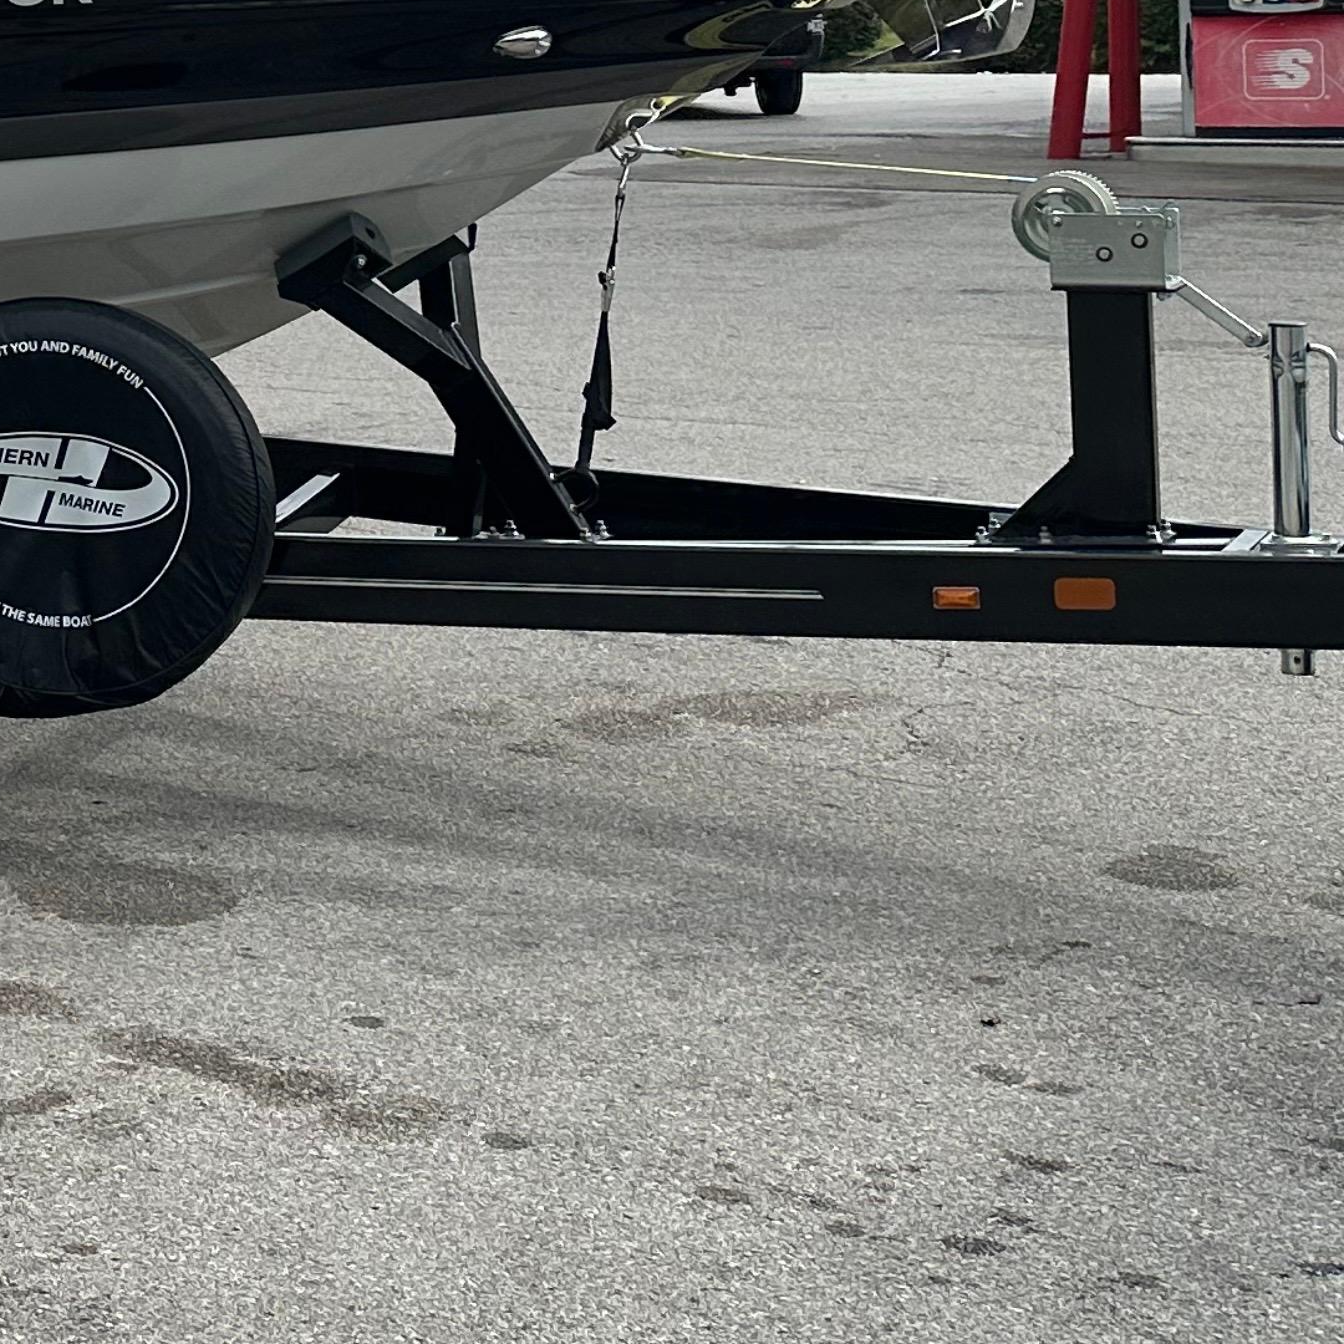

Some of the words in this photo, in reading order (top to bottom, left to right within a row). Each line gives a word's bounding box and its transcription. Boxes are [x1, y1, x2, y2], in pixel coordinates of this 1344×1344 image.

[10, 340, 38, 354] YOU
[41, 340, 70, 354] AND
[72, 344, 118, 370] FAMILY
[116, 364, 144, 389] FUN
[58, 492, 126, 518] MARINE
[2, 603, 26, 621] THE
[26, 612, 61, 627] SAME
[63, 614, 92, 627] BOAT
